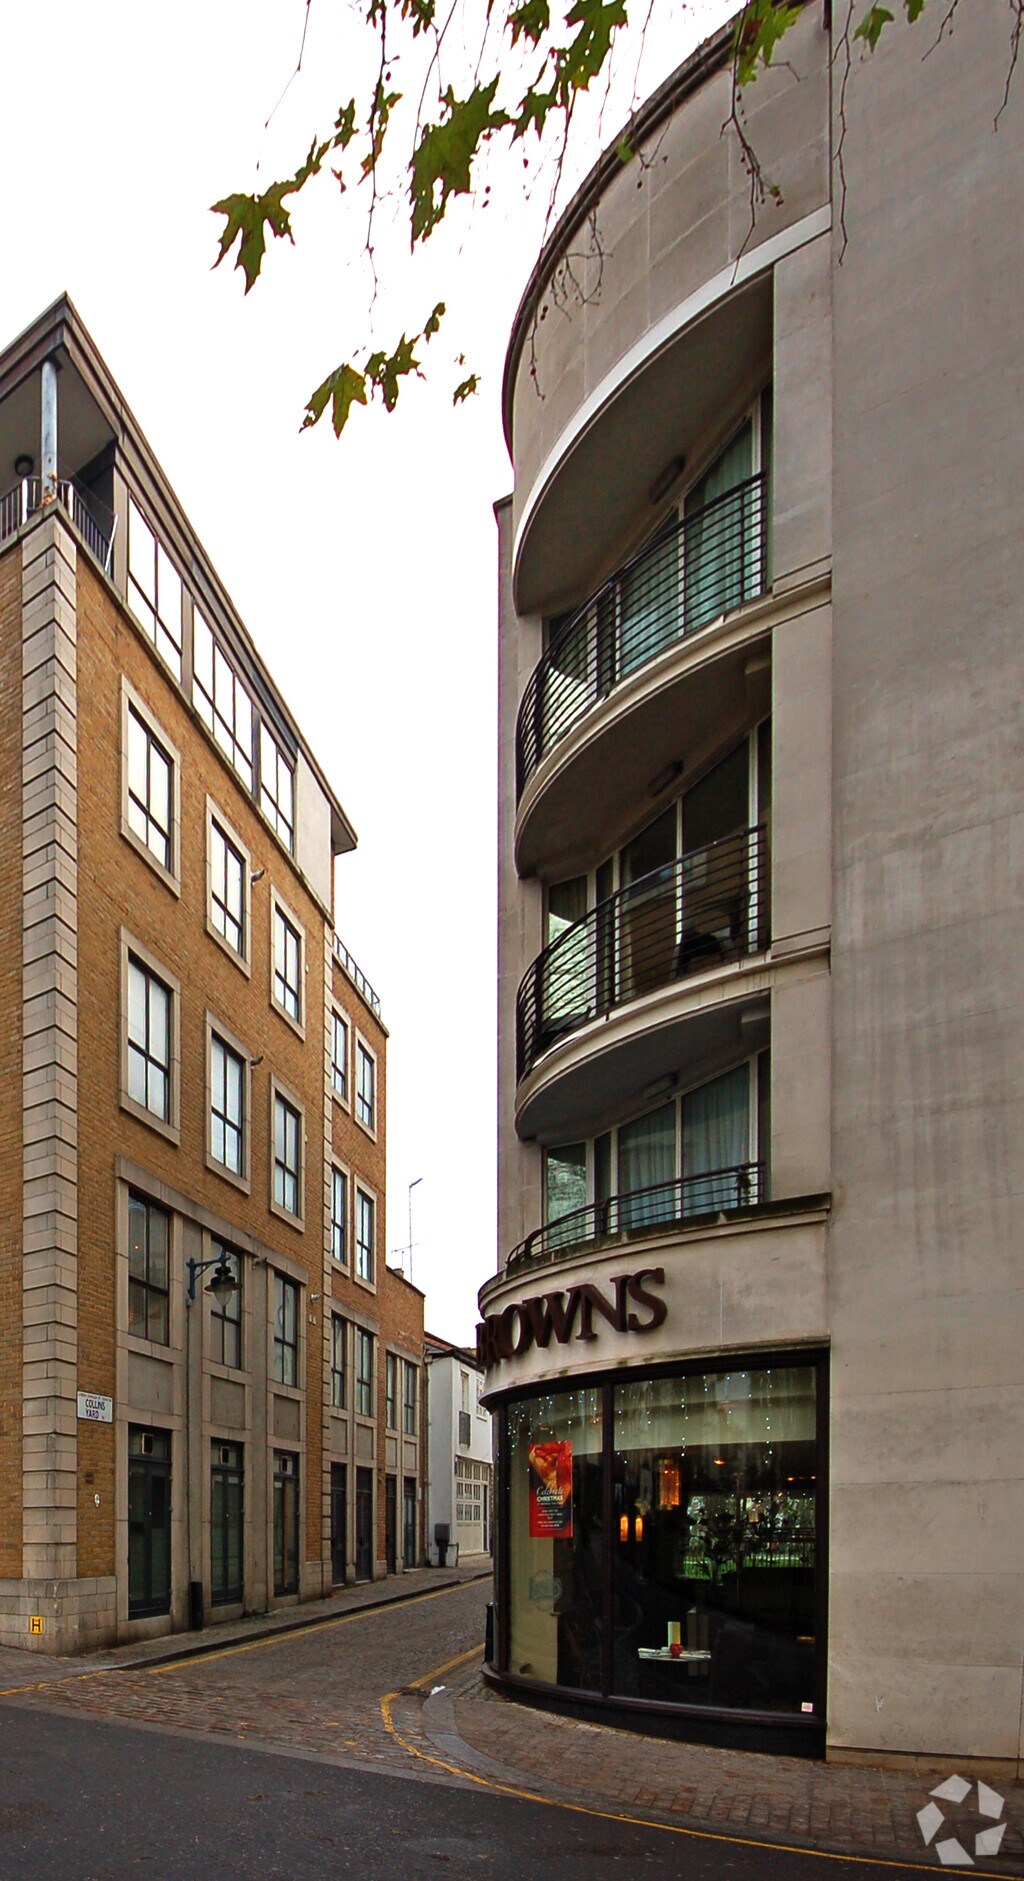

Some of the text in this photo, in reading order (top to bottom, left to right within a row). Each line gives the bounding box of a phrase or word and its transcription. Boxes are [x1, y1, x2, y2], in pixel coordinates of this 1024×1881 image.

[85, 1399, 106, 1411] COLLINS
[85, 1408, 100, 1419] YARD
[32, 1618, 41, 1632] H
